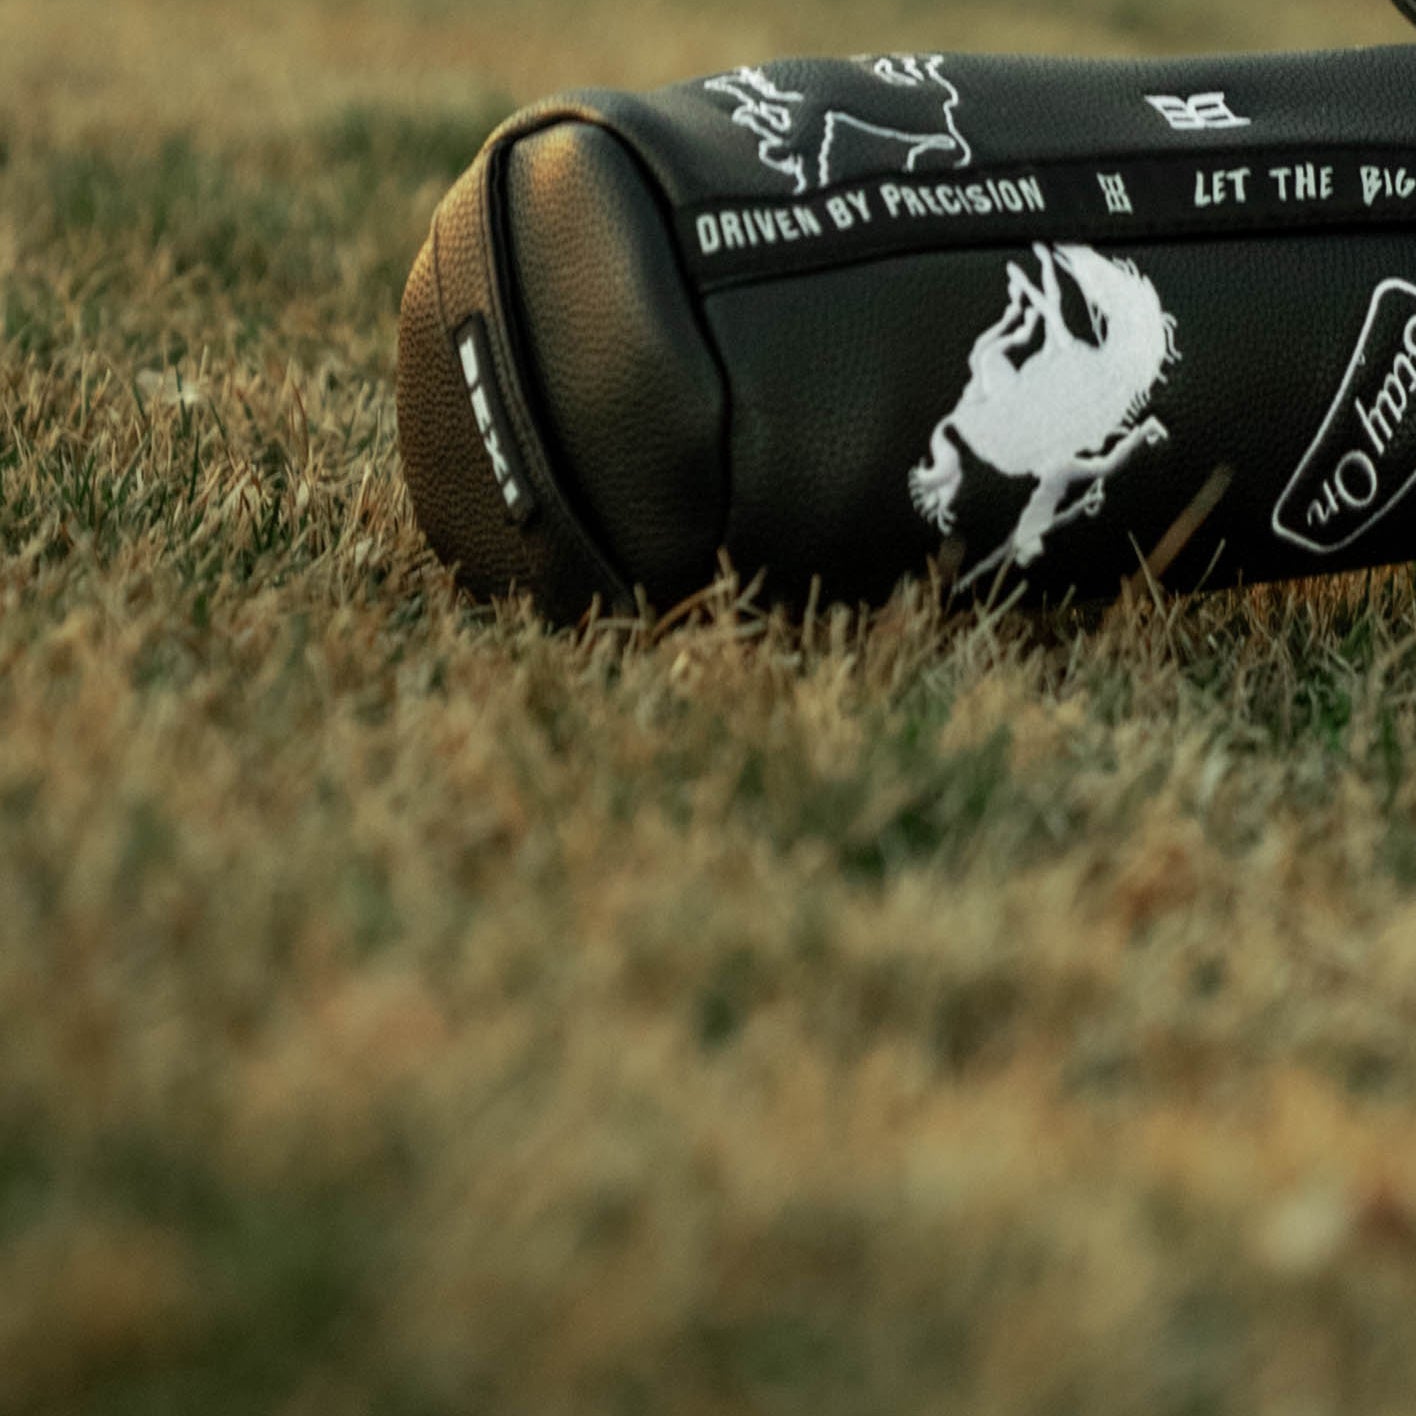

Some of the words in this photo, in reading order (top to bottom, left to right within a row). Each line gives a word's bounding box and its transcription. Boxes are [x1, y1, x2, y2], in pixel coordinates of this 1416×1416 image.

[1194, 168, 1250, 206] LET
[1269, 162, 1333, 201] THE
[1360, 166, 1416, 206] BIG
[696, 204, 821, 254] DRIVEN
[826, 189, 871, 229] BY
[1307, 449, 1377, 526] On
